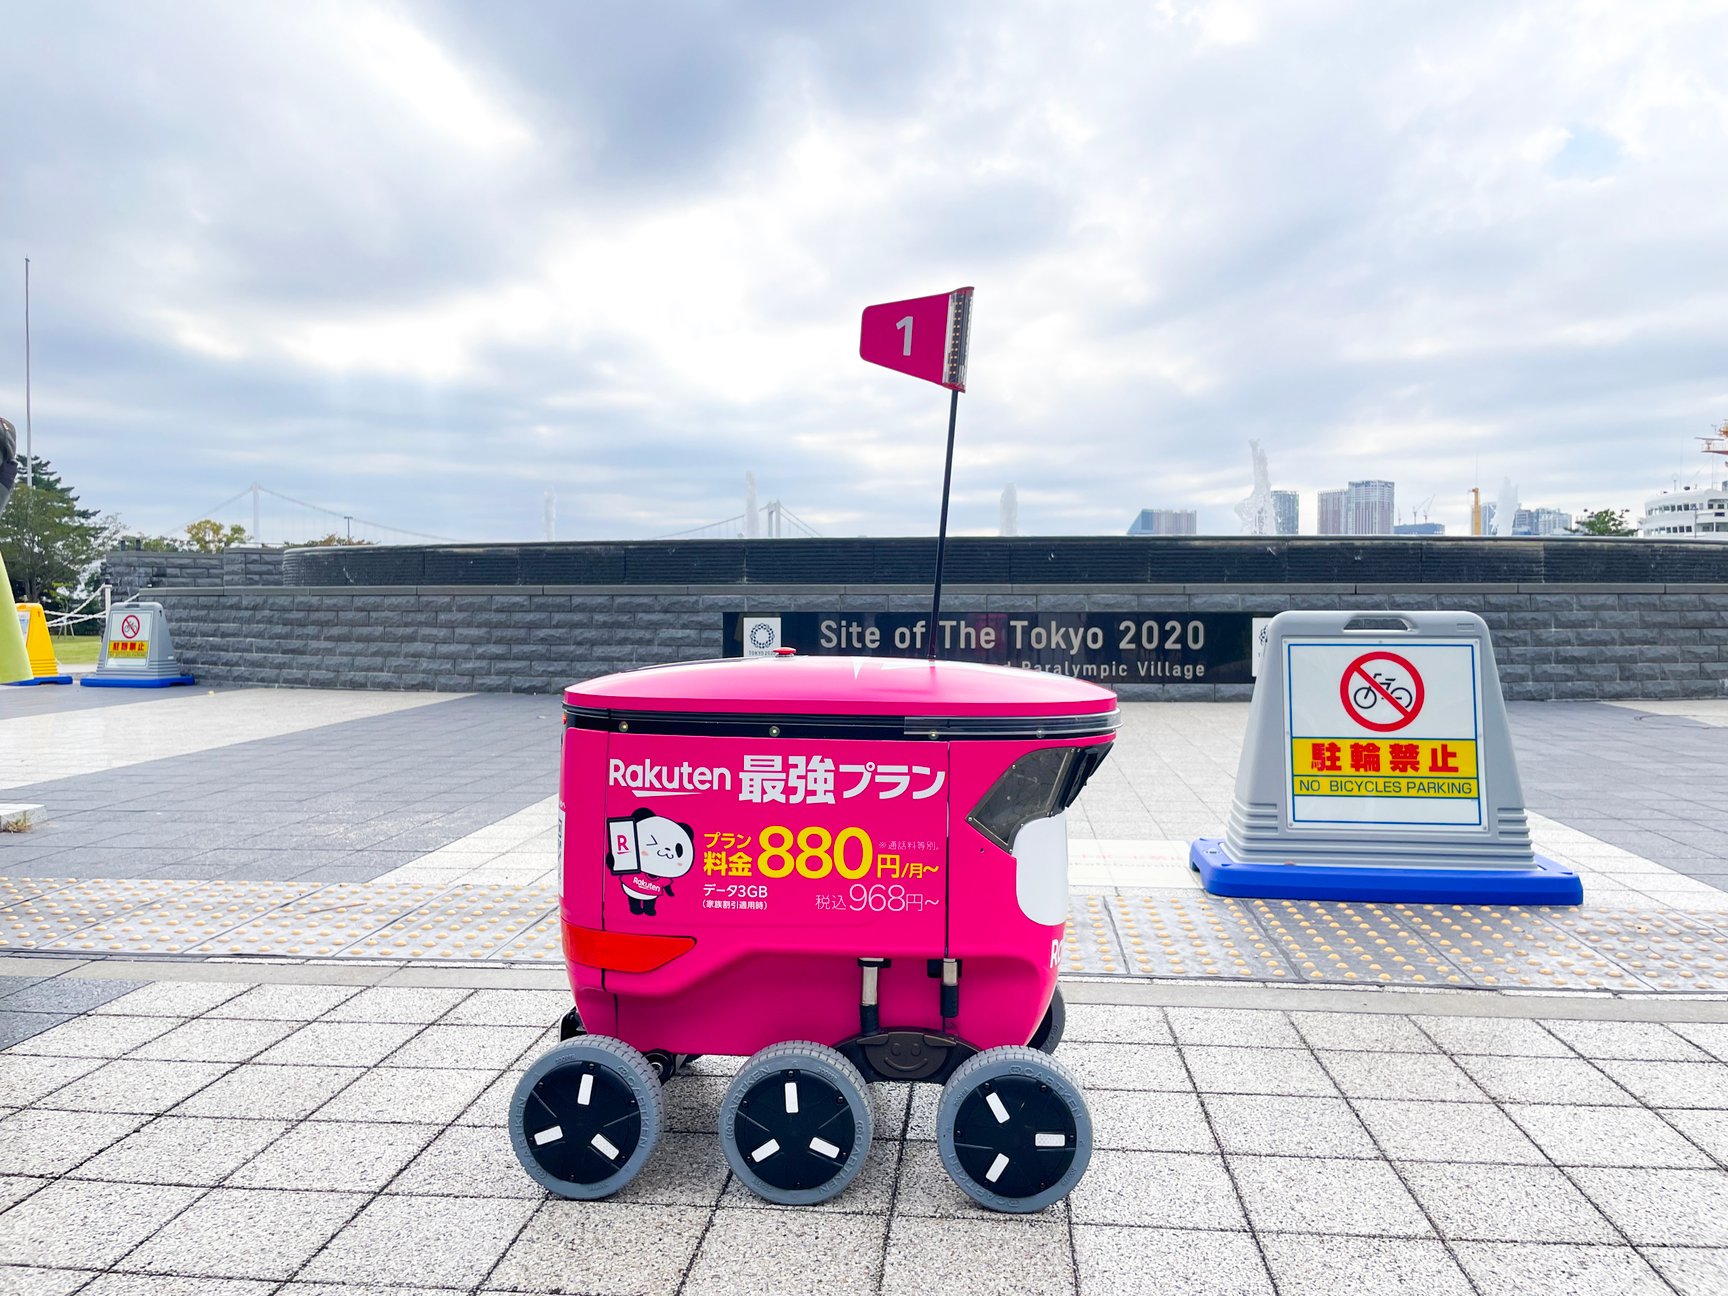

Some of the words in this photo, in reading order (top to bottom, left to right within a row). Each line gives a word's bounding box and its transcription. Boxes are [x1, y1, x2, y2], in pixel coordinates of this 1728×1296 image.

[896, 316, 914, 356] 1
[820, 620, 881, 650] Site
[894, 619, 927, 650] of
[939, 620, 996, 650] The
[1010, 620, 1104, 656] Tokyo
[1119, 620, 1206, 650] 2020
[1137, 661, 1205, 679] Village
[1311, 742, 1459, 773] 駐輪禁止
[609, 758, 732, 794] Rakuten
[738, 755, 946, 804] 最強プラン
[1299, 780, 1321, 791] NO
[1329, 780, 1402, 793] BICYCLES
[1406, 781, 1472, 794] PARKING
[617, 835, 629, 852] R
[703, 832, 752, 849] プラン
[703, 851, 753, 877] 料金
[633, 877, 661, 893] Rakuten
[703, 884, 768, 898] データ3GB
